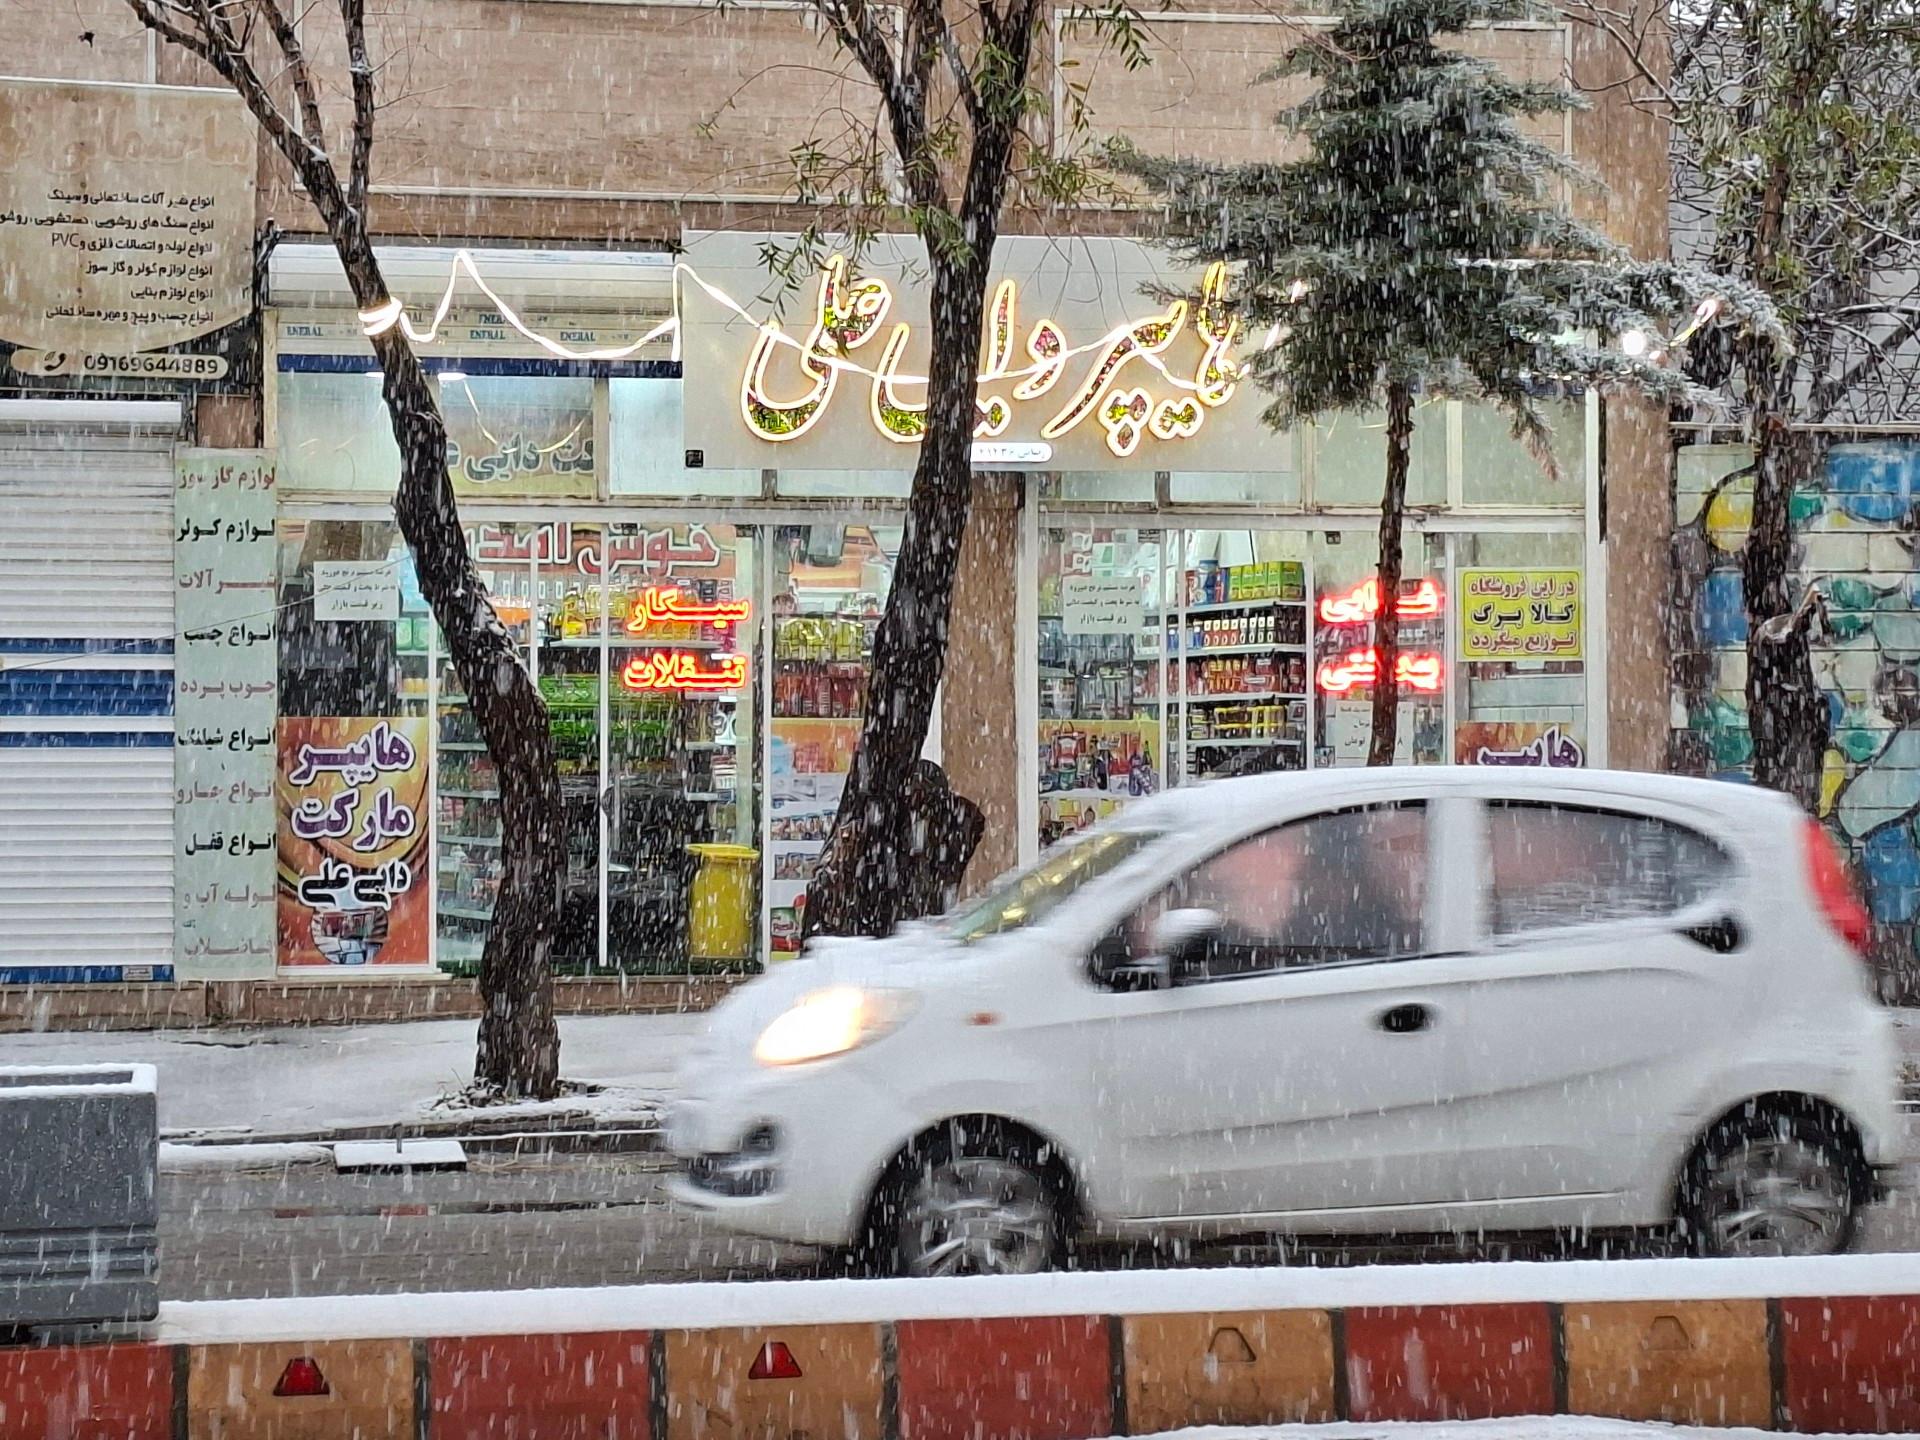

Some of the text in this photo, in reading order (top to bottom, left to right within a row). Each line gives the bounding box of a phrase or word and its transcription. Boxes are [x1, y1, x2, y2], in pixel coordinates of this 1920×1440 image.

[141, 191, 165, 204] آلات
[189, 195, 215, 212] انواع
[161, 215, 188, 228] سنگ
[189, 219, 215, 235] انواع
[51, 232, 79, 248] PVC
[157, 243, 163, 254] و
[165, 241, 186, 254] لوله
[188, 242, 213, 258] انواع
[86, 261, 108, 275] سوز
[127, 265, 133, 276] و
[159, 263, 186, 277] لوازم
[188, 265, 213, 281] انواع
[159, 286, 187, 300] لوازم
[188, 288, 213, 304] انواع
[131, 310, 149, 326] پیچ
[158, 312, 188, 326] چسب
[188, 311, 214, 327] انواع
[211, 465, 234, 490] گاز
[238, 466, 275, 490] لوازم
[176, 517, 275, 542] لوازم کولر
[179, 568, 214, 589] آلات
[1470, 575, 1576, 598] در این فروشگاه
[626, 585, 750, 632] سیگار
[1531, 602, 1575, 622] کالا
[183, 622, 277, 648] انواع چسب
[1525, 631, 1576, 652] توزیع
[623, 652, 747, 690] تنقلات
[180, 678, 276, 700] چوب پرده
[227, 726, 277, 751] انواع
[289, 720, 416, 786] هایپر
[175, 780, 277, 805] انواع جارو
[291, 786, 416, 852] مارکت
[184, 831, 277, 856] انواع قفل
[183, 882, 276, 909] لوله آب و
